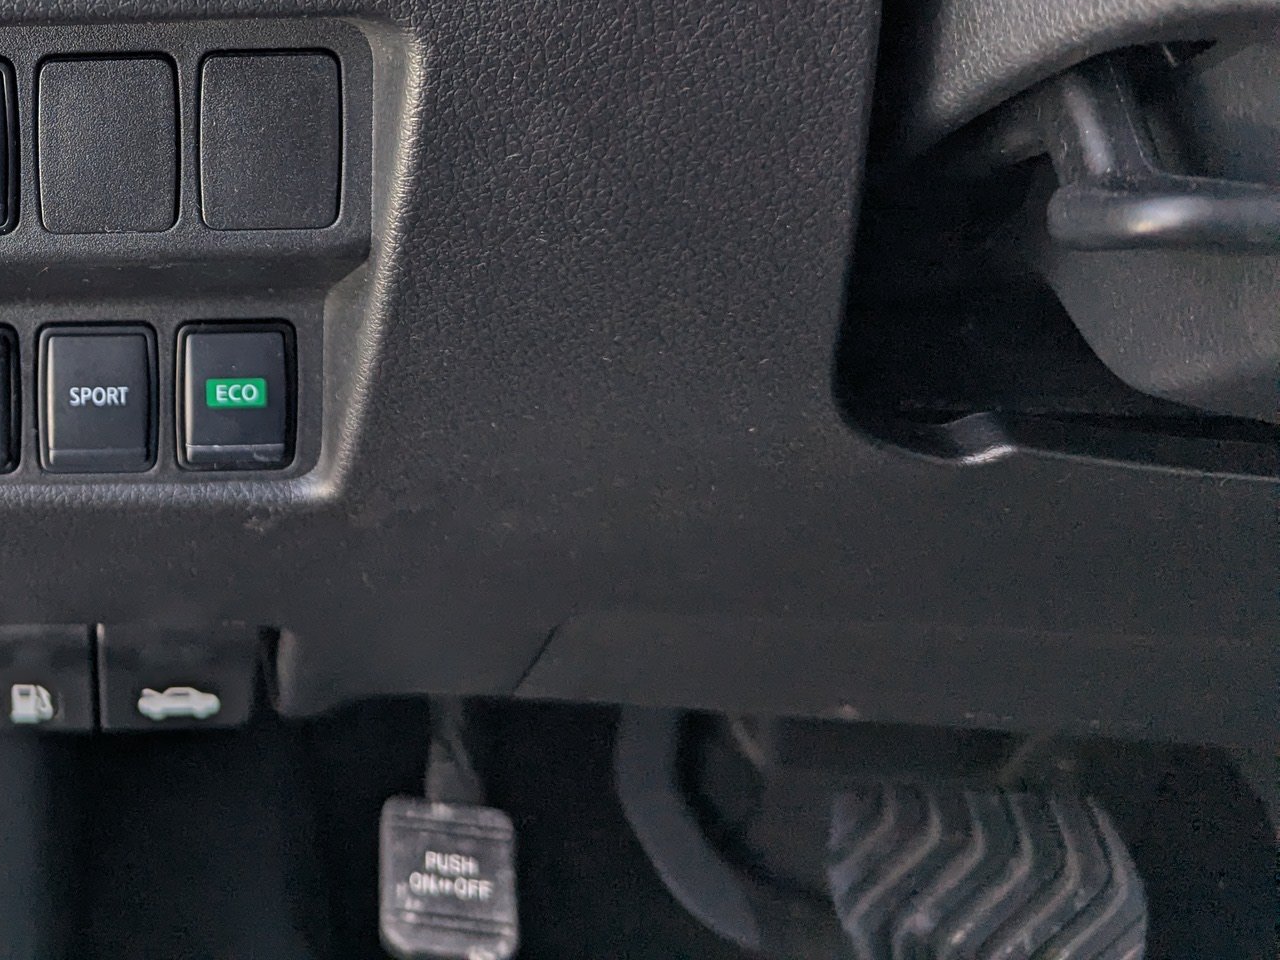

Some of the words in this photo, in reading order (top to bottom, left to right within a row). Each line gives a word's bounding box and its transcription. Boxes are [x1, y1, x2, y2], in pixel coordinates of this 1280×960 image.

[69, 385, 129, 407] SPORT
[215, 383, 259, 404] ECO
[425, 851, 480, 877] PUSH
